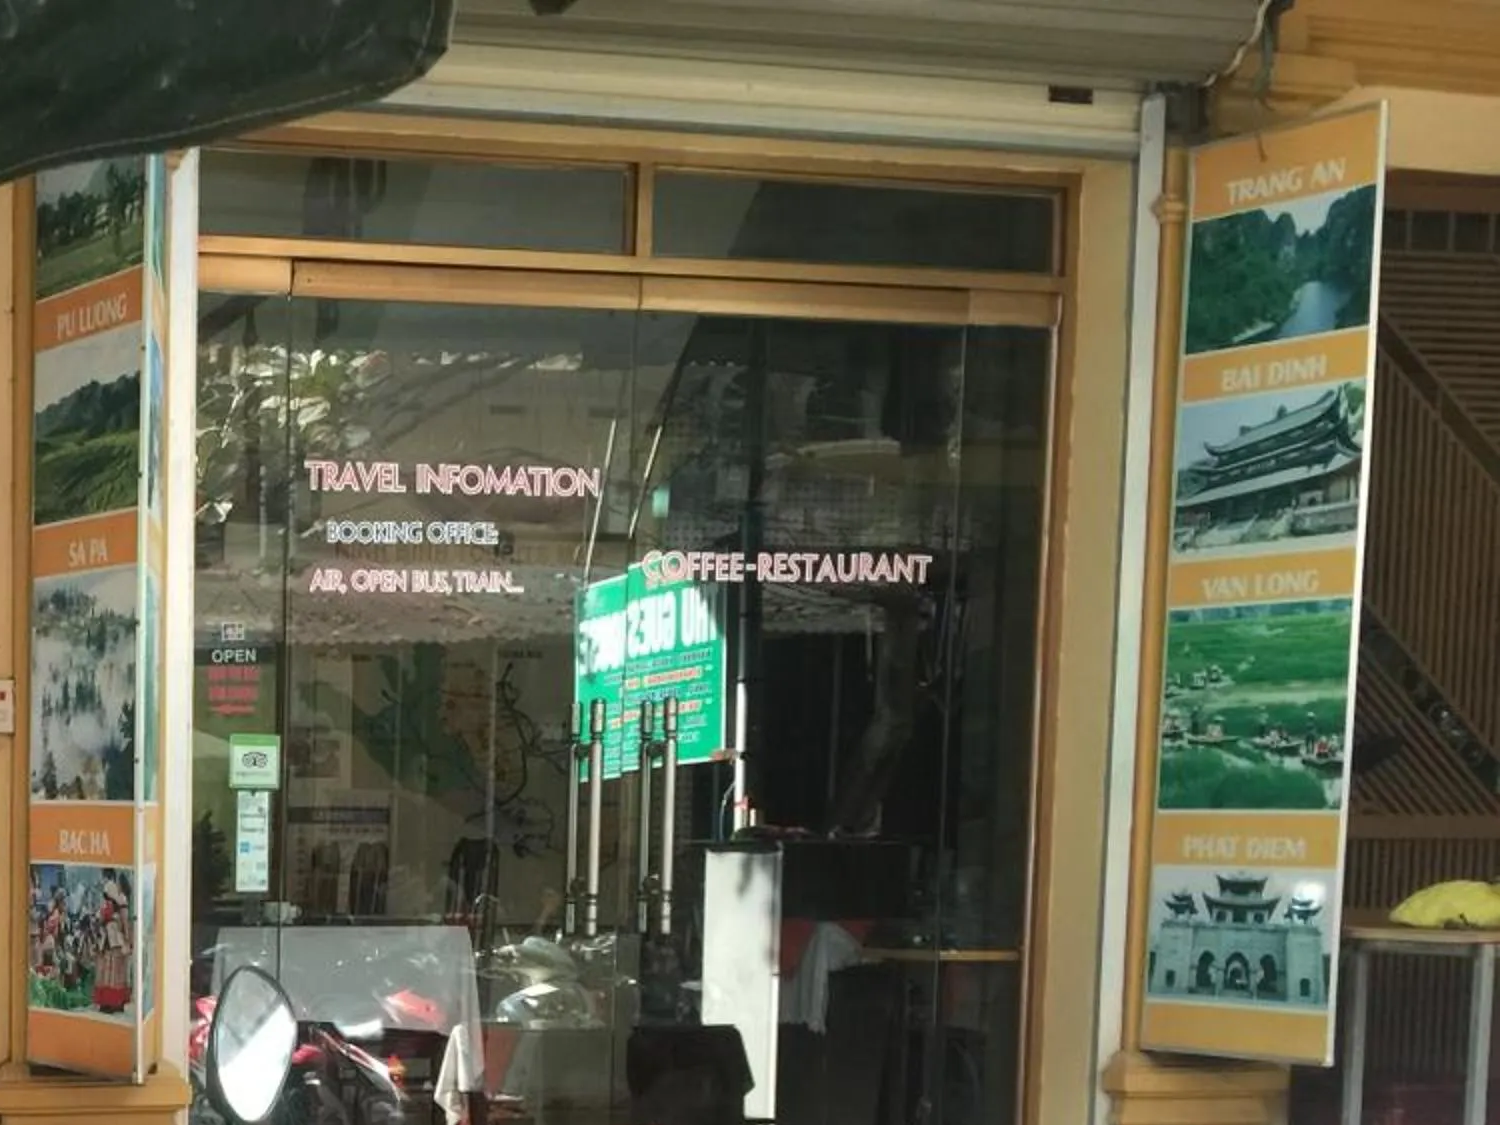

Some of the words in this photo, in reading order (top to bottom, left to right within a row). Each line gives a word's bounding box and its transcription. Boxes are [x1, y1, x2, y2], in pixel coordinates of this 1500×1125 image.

[1227, 166, 1306, 205] TRANG
[1310, 157, 1347, 189] AN
[56, 309, 76, 341] PU
[1221, 365, 1261, 392] BAI
[1267, 354, 1327, 385] DINH
[303, 460, 406, 493] TRAVEL
[415, 463, 601, 498] INFOMATION
[326, 520, 423, 545] BOOKING
[68, 539, 86, 568] SA
[89, 537, 108, 565] PA
[350, 569, 406, 593] OPEN
[1202, 574, 1248, 600] VAN
[1254, 569, 1320, 596] LONG
[211, 648, 257, 663] OPEN
[59, 829, 88, 855] BAC
[90, 831, 111, 856] HA
[1182, 834, 1241, 859] PHAT
